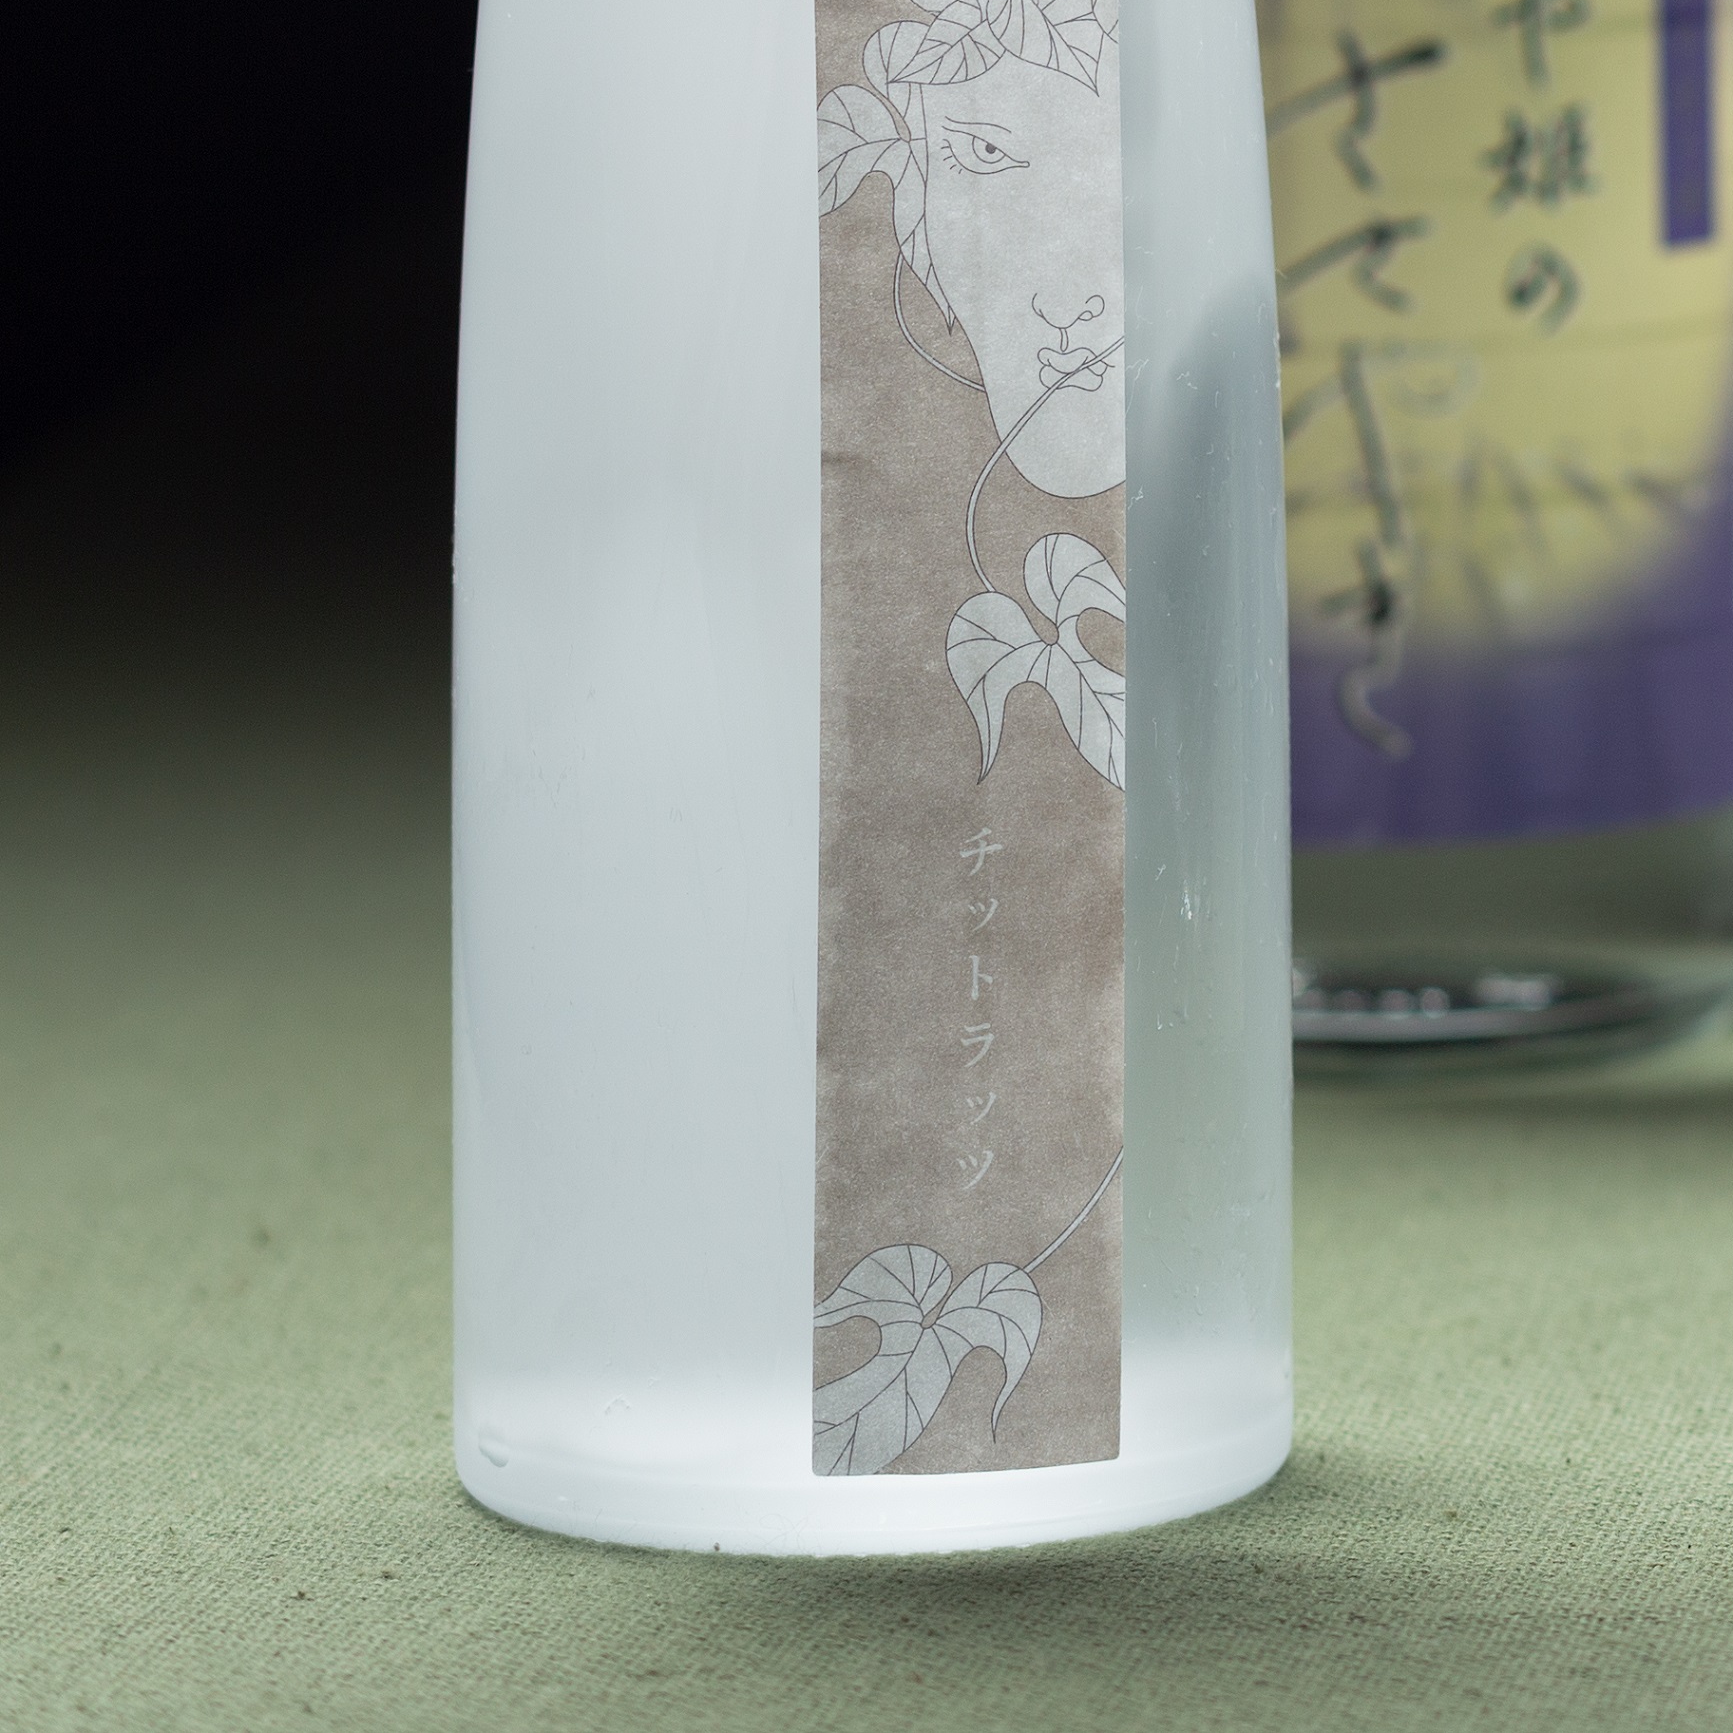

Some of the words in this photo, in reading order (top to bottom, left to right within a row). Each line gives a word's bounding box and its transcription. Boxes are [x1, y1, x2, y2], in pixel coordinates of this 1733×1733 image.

[957, 825, 1004, 1193] チットラッツ
